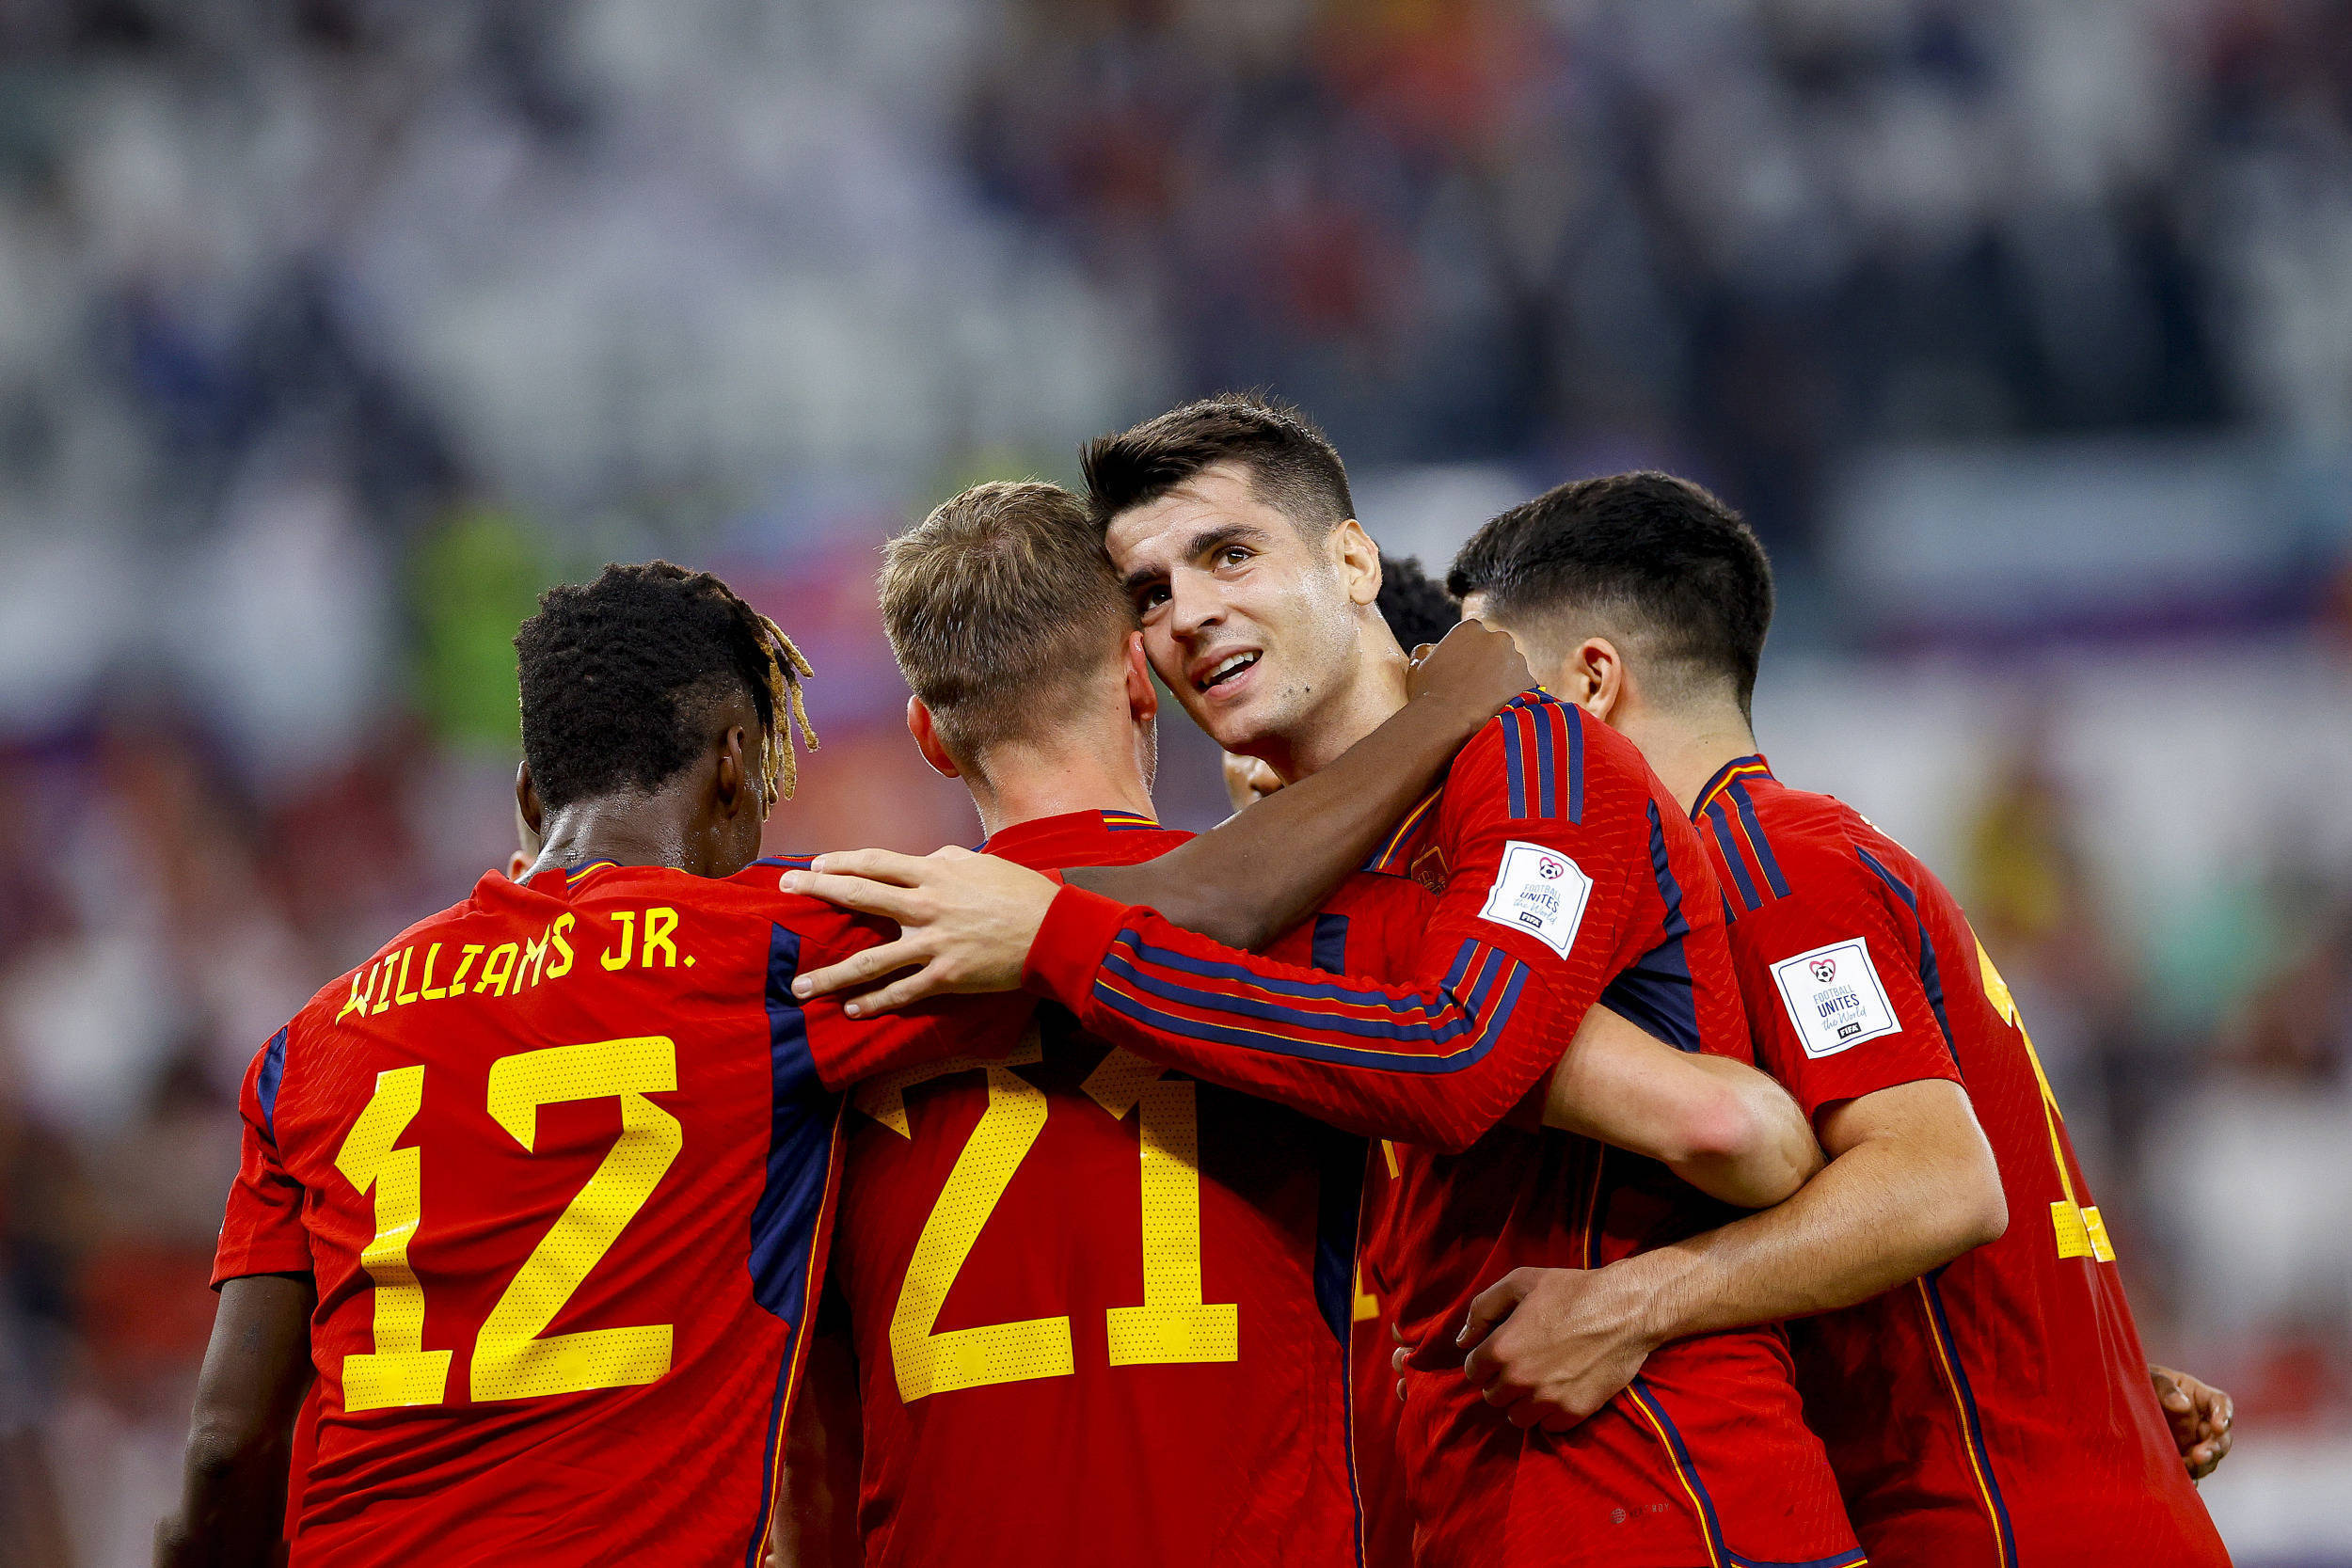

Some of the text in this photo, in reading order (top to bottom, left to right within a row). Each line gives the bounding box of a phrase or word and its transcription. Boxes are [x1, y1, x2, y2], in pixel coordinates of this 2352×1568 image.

[1519, 892, 1560, 913] UNITES
[1524, 883, 1561, 904] FOOTBALL
[335, 906, 697, 1026] WILLIAMS JR.
[1813, 984, 1855, 1005] FOOTBALL
[1817, 993, 1860, 1018] UNITES
[1821, 1006, 1867, 1031] the World
[1839, 1022, 1860, 1037] FIFA
[334, 1035, 683, 1413] 12
[853, 1023, 1238, 1404] 21
